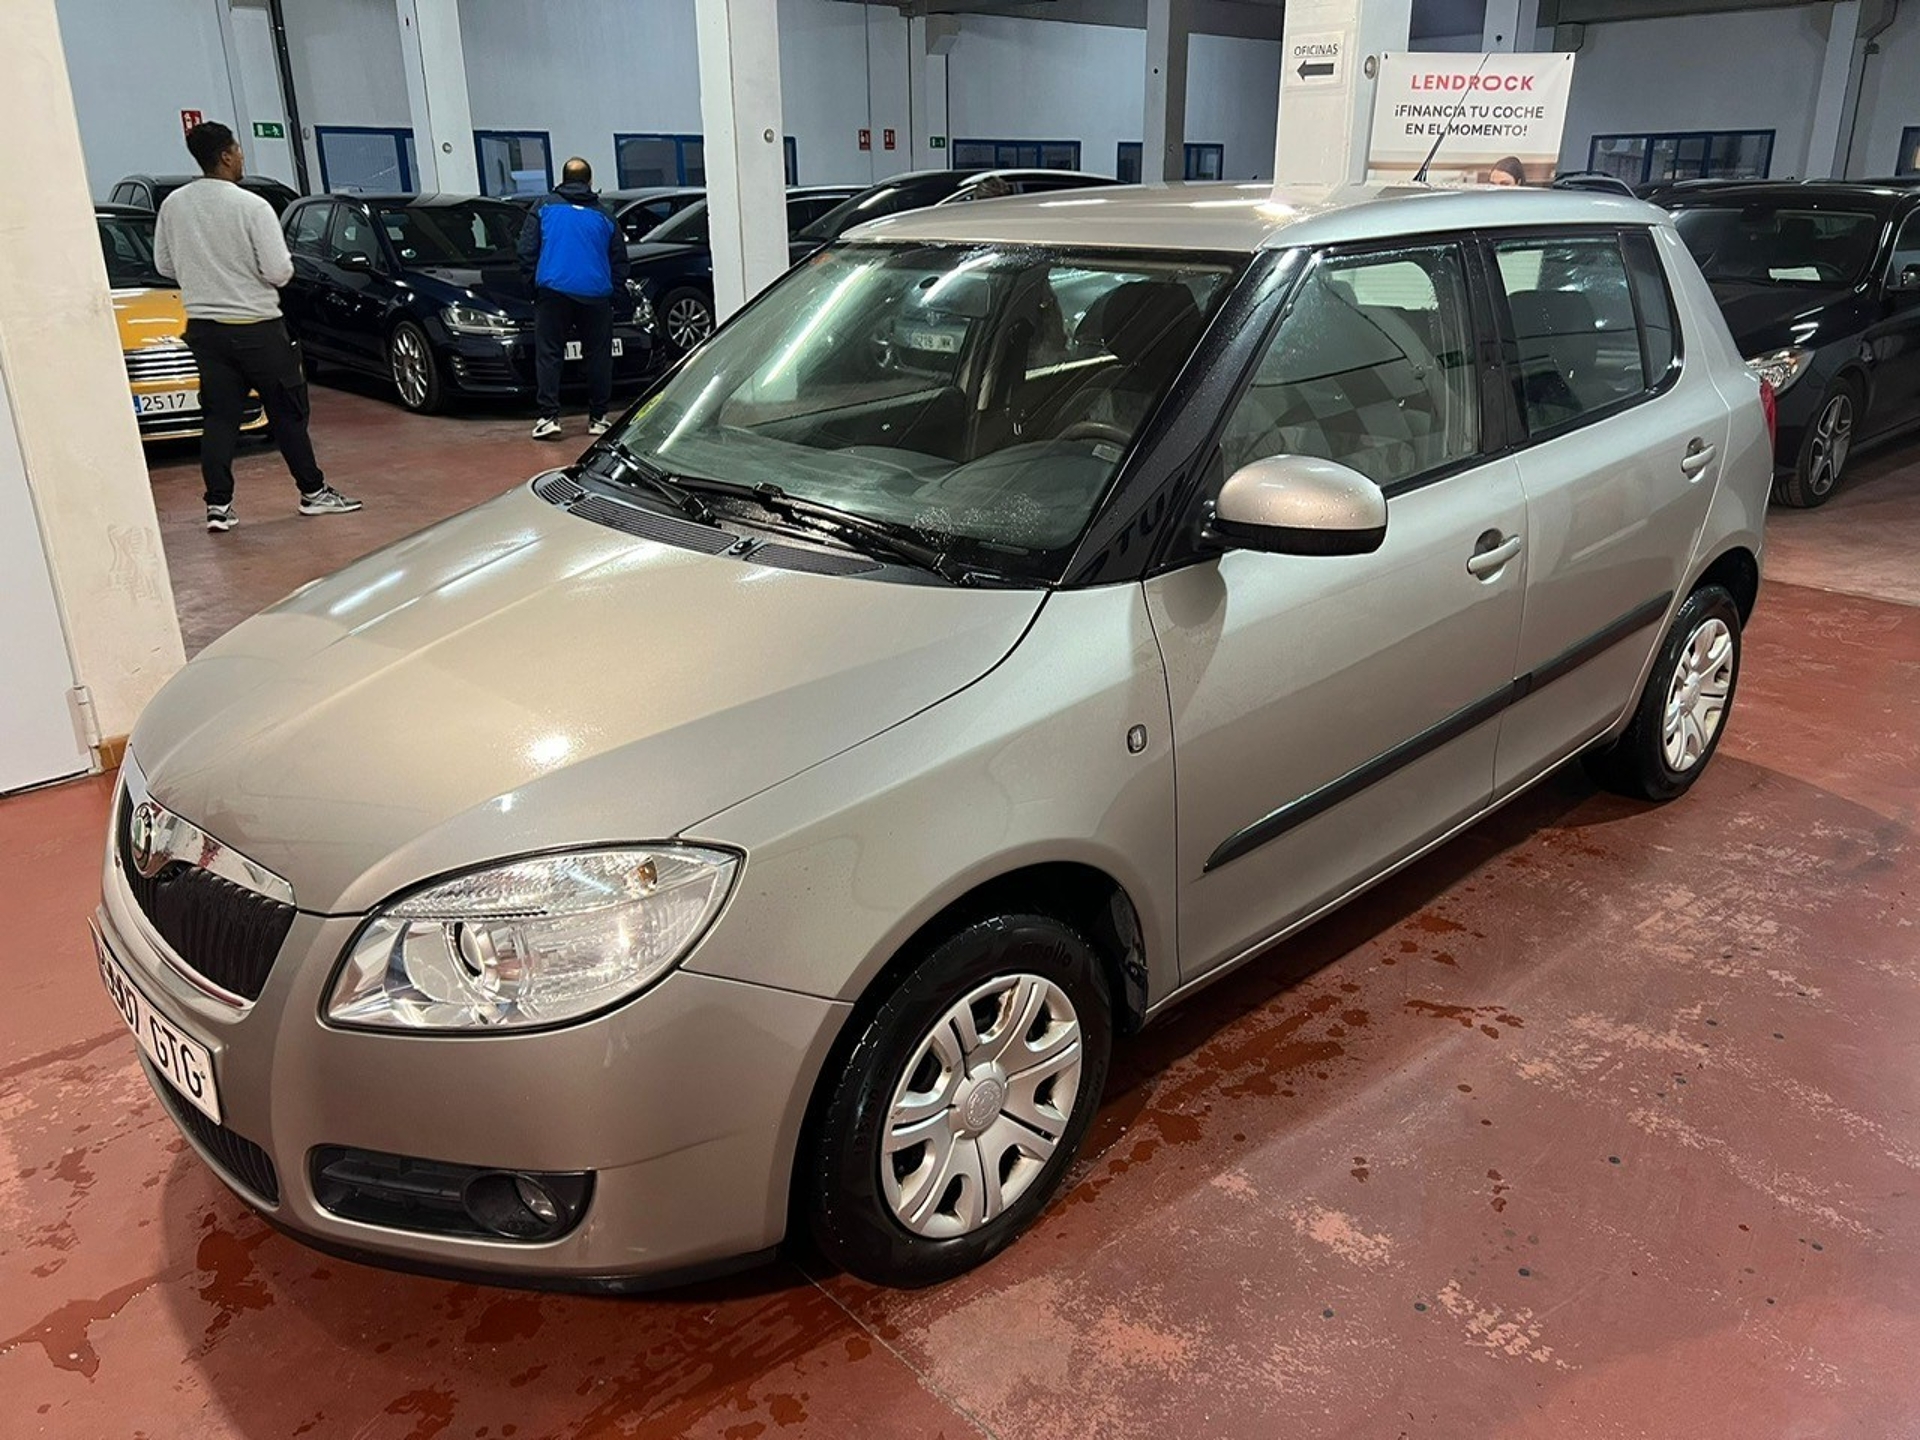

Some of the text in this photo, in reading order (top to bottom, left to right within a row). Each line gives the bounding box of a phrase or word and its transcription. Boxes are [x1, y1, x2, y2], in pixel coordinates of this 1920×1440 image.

[1294, 43, 1339, 56] OFICINAS
[1411, 74, 1535, 91] LENDROCK
[1395, 104, 1545, 119] ¡FINANCIA TU COCHE
[1405, 123, 1528, 137] EN EL MOMENTO!
[142, 393, 187, 412] 2517
[150, 1014, 203, 1099] GTG
